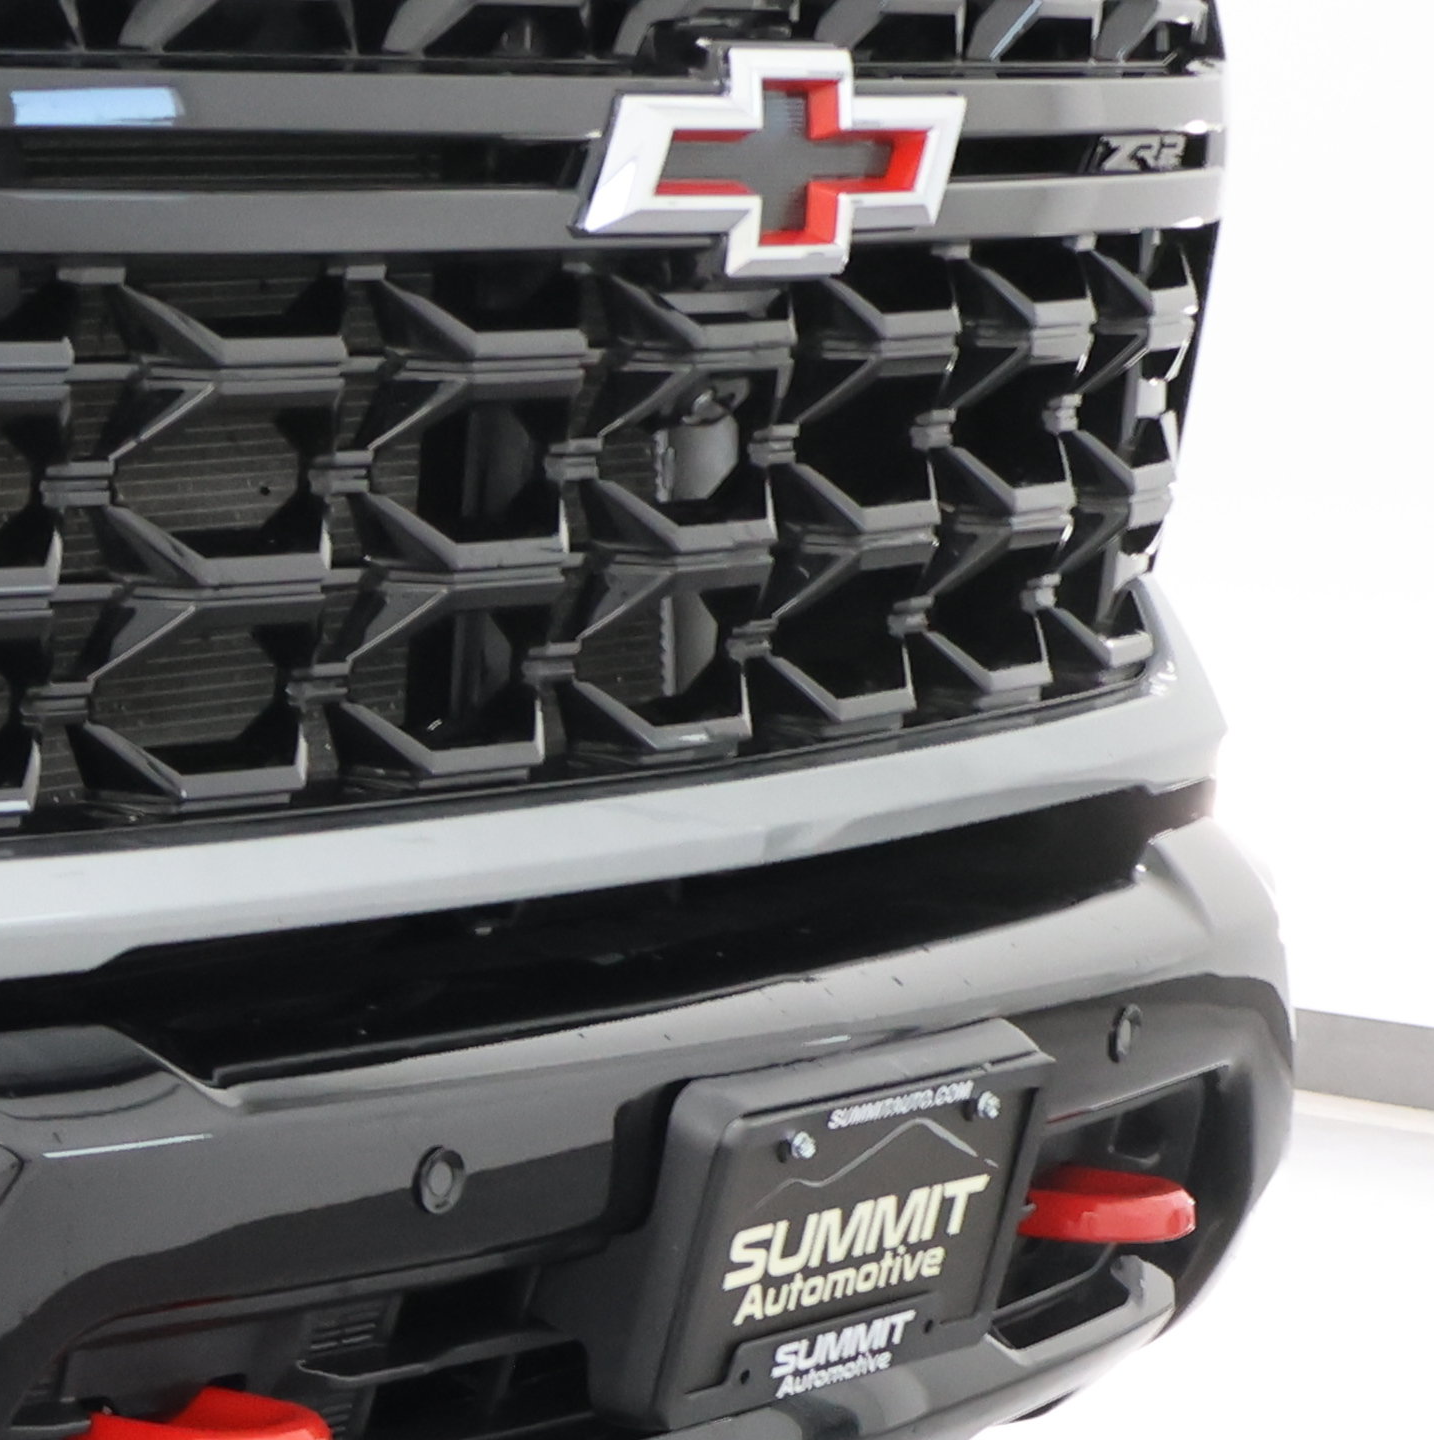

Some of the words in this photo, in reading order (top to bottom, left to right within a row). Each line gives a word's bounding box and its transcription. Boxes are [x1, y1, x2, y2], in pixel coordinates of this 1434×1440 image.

[1099, 133, 1187, 173] ZR2
[827, 1079, 974, 1130] SUMMITAUTO.COM
[723, 1173, 991, 1291] SUMMIT
[732, 1245, 946, 1326] Automotive
[770, 1309, 917, 1379] SUMMIT
[775, 1351, 893, 1399] Automotive
